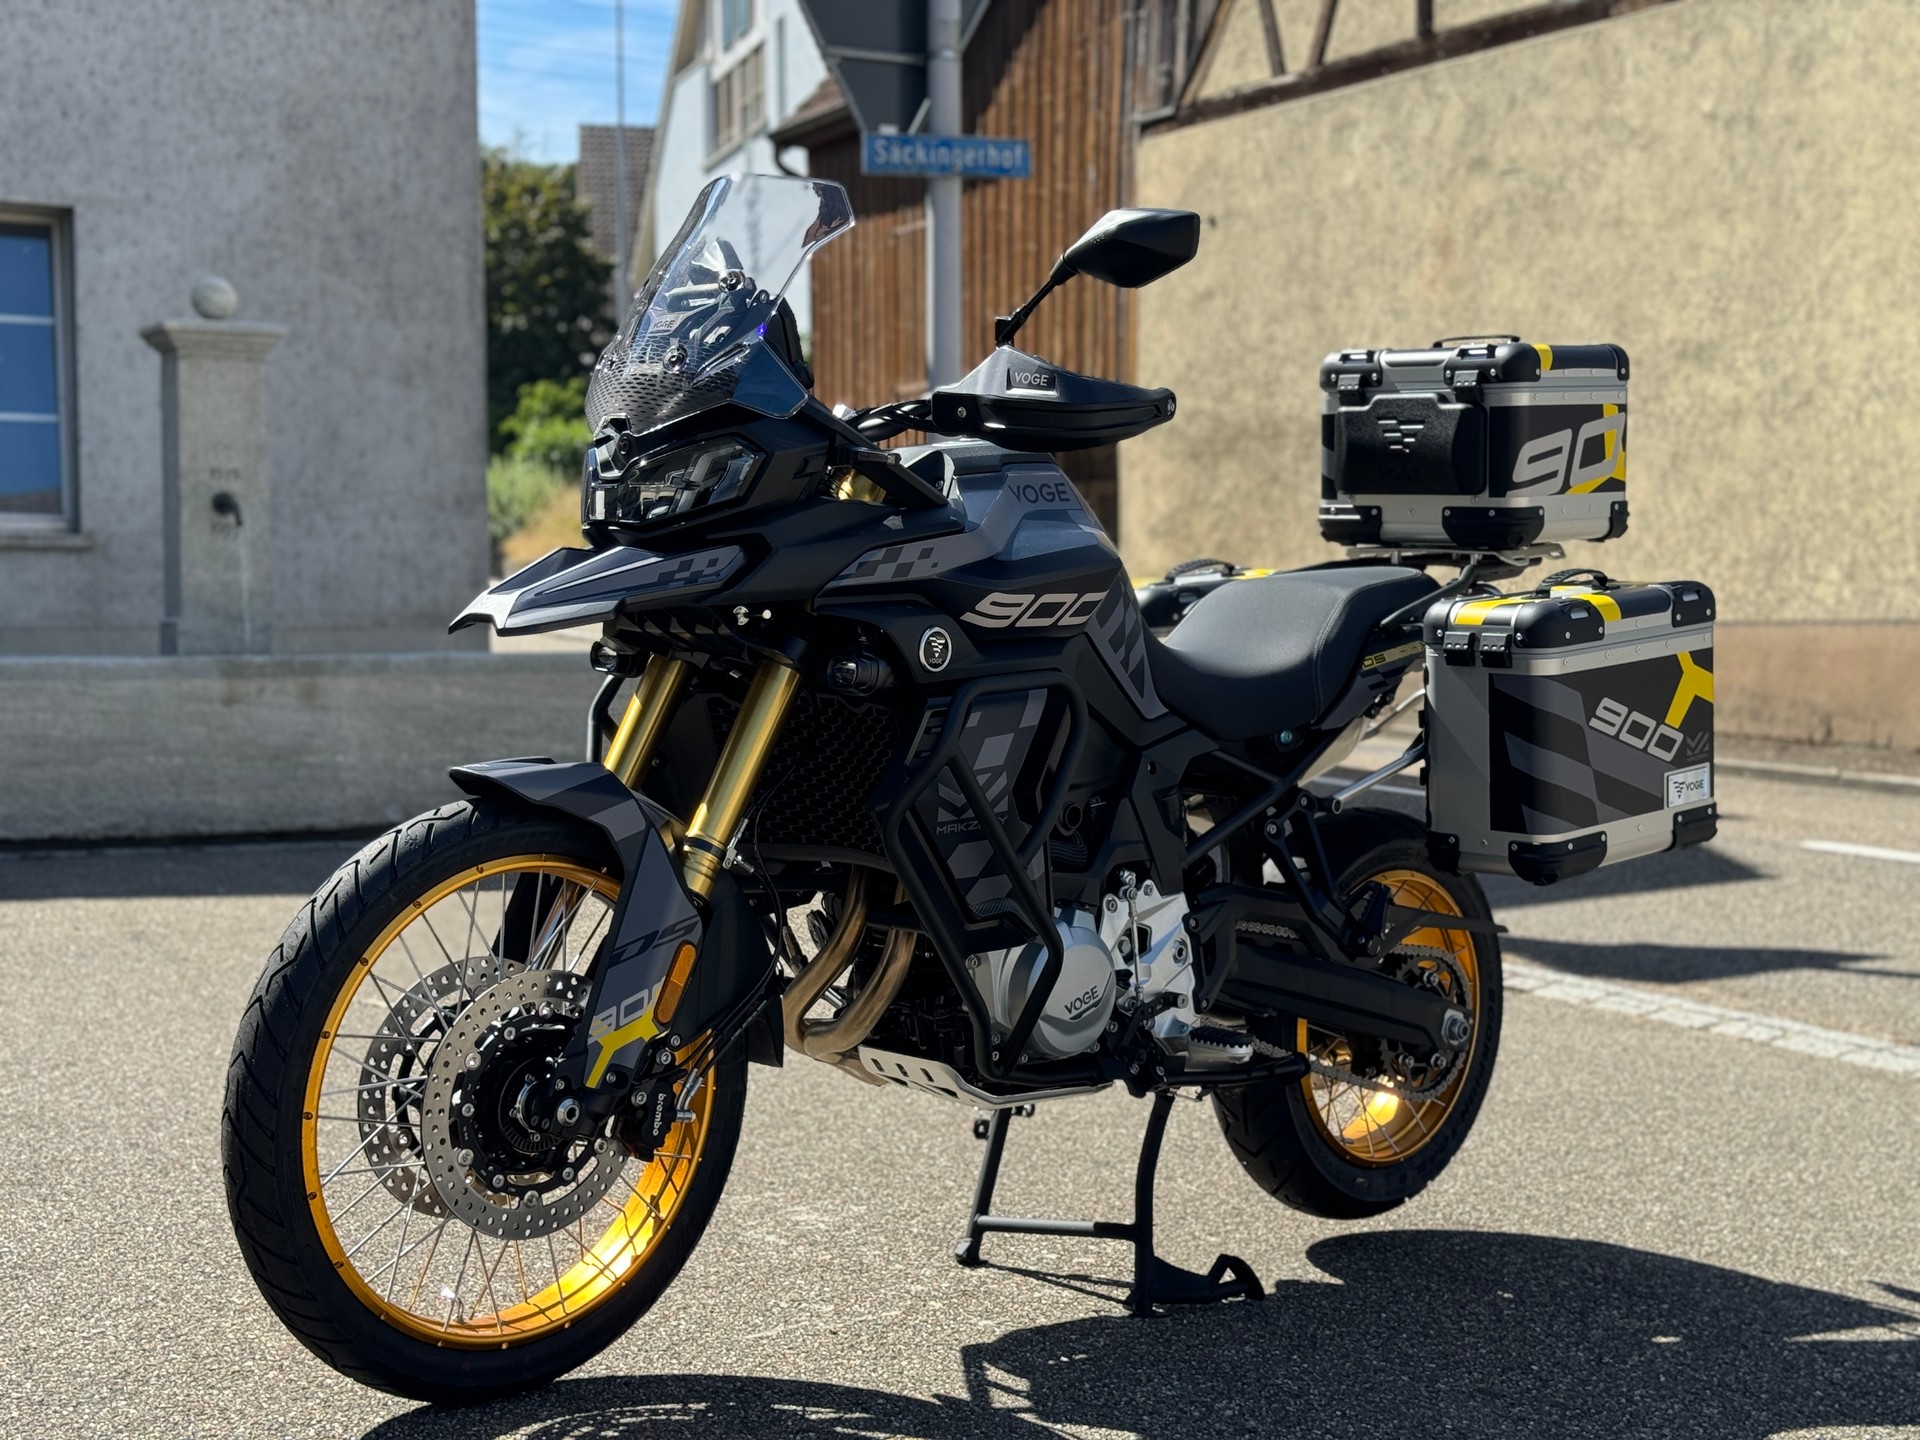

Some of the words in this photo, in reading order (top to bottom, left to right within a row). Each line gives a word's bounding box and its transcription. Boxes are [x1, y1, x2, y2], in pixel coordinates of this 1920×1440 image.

[1014, 371, 1050, 386] VOGE
[1008, 483, 1070, 504] VOGE
[1588, 696, 1685, 762] 900
[1685, 779, 1704, 791] VOGE
[1064, 985, 1099, 1014] VOGE
[652, 1093, 667, 1137] brembo
